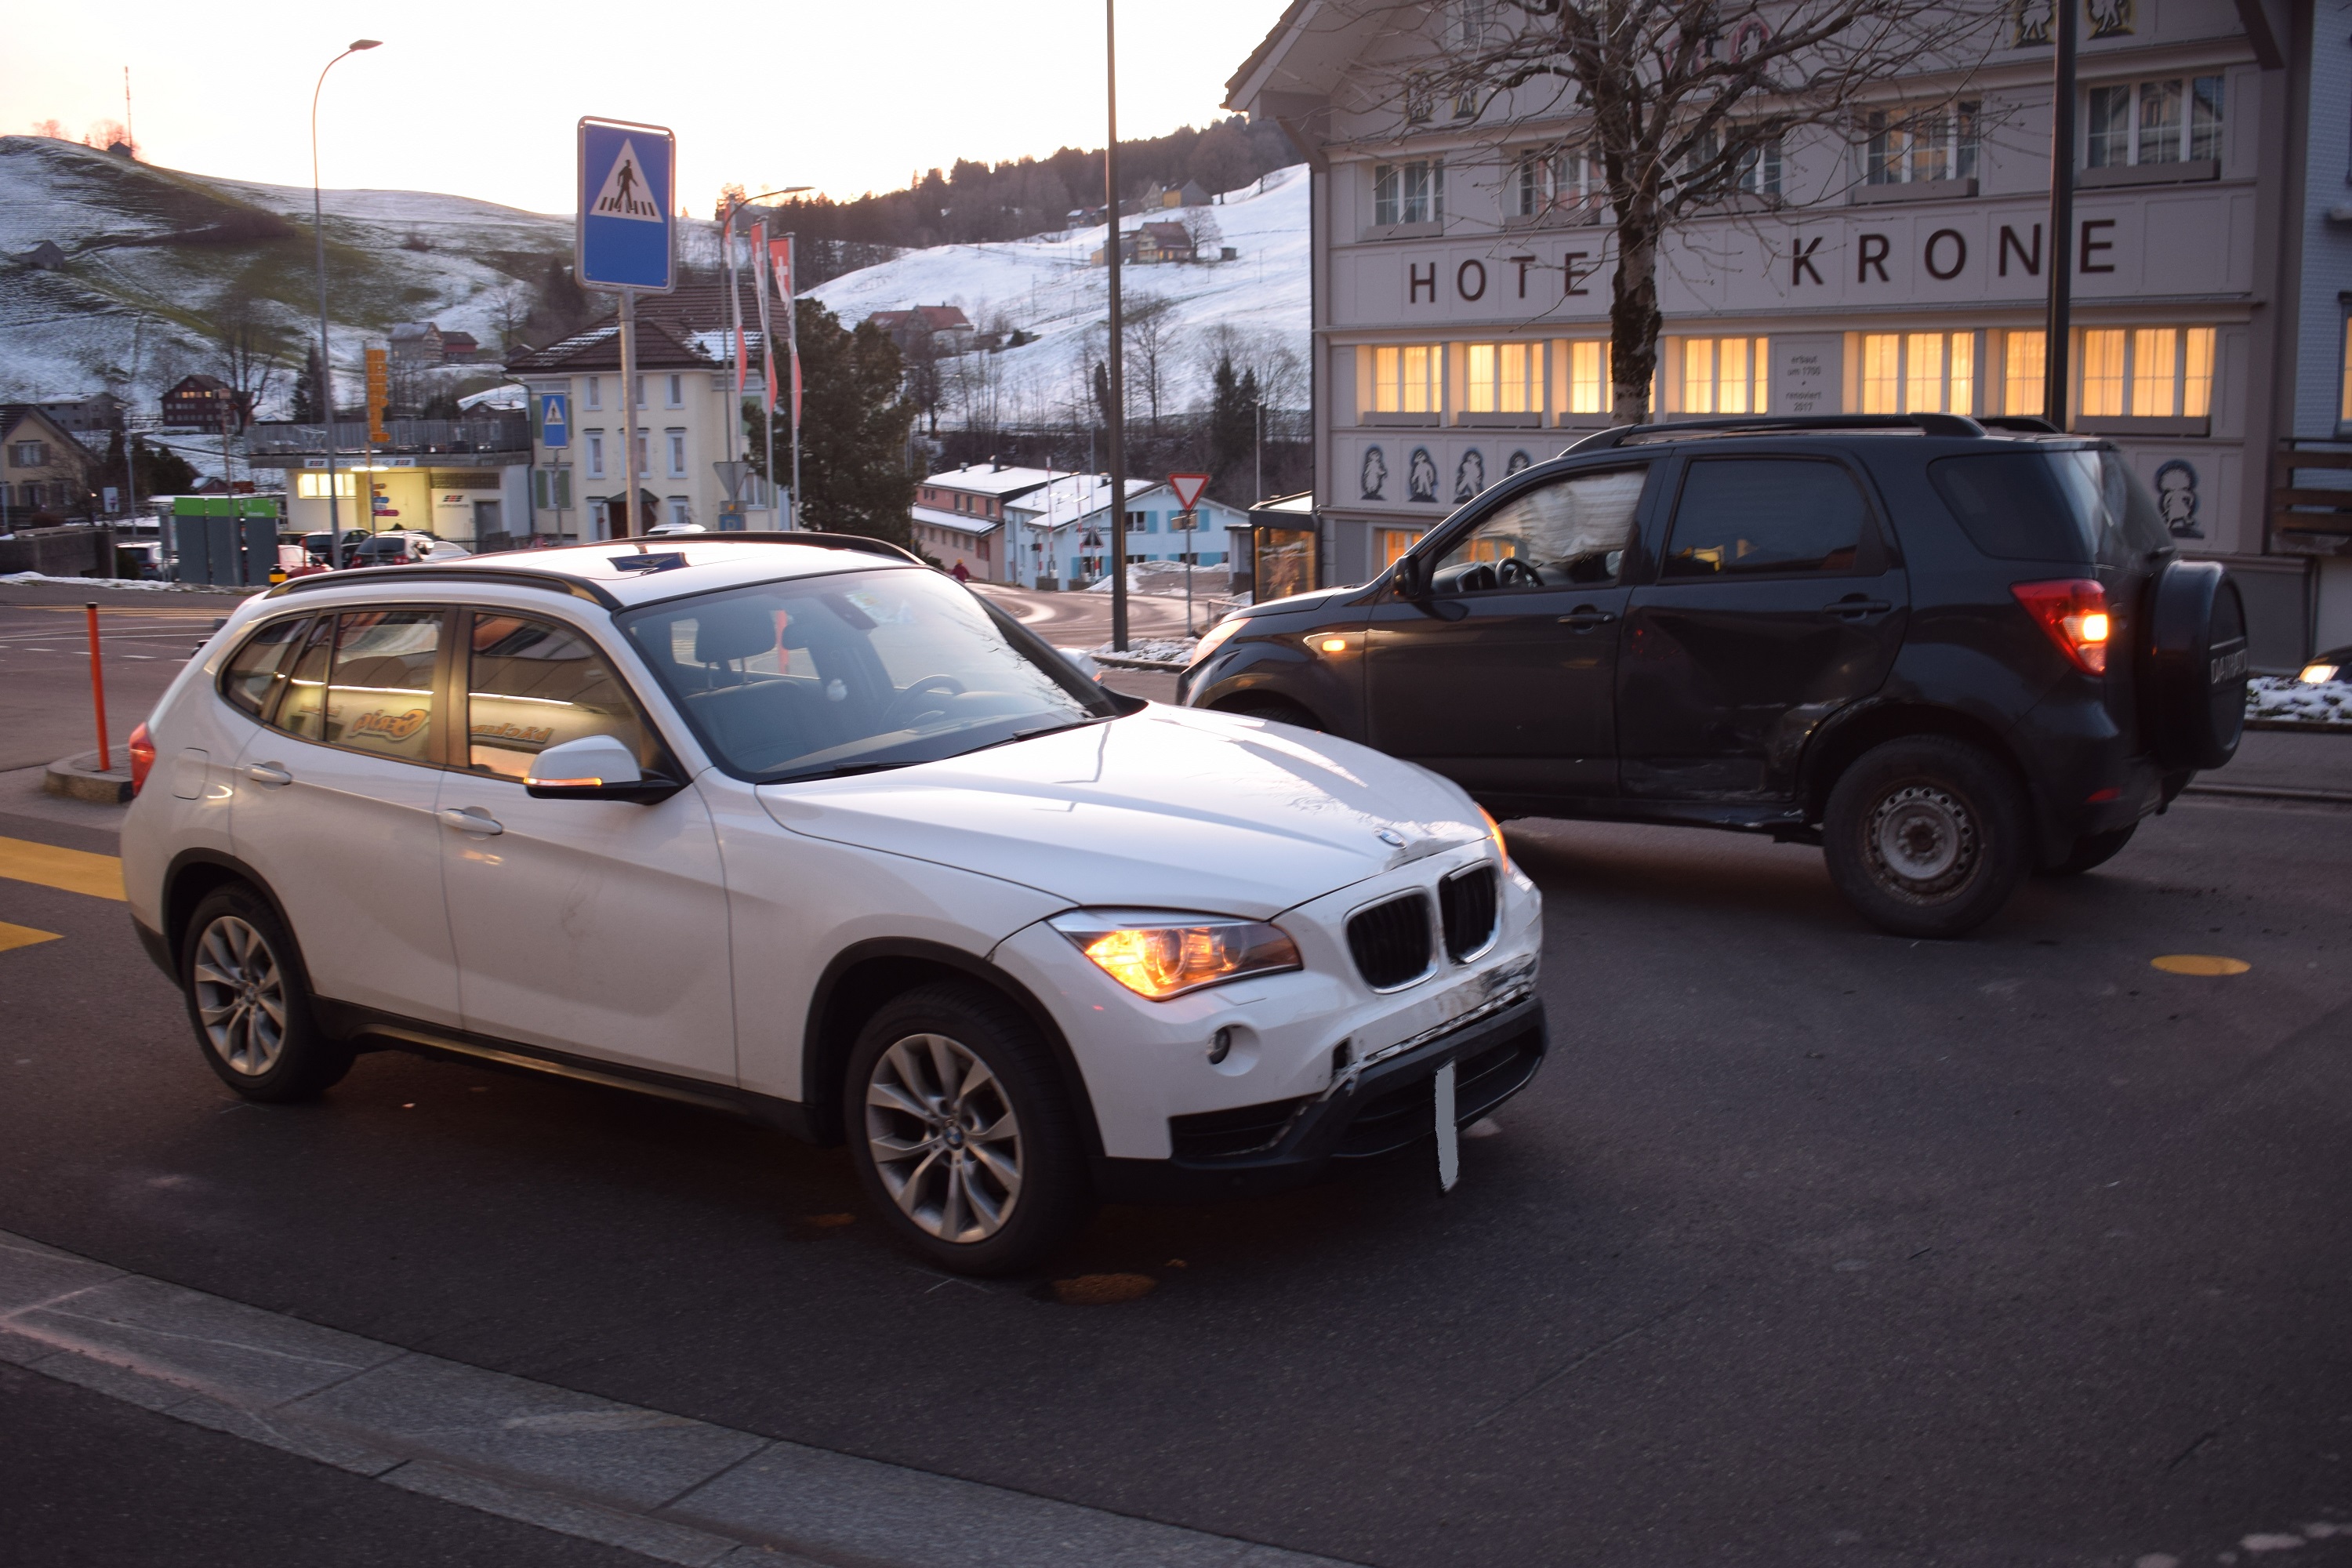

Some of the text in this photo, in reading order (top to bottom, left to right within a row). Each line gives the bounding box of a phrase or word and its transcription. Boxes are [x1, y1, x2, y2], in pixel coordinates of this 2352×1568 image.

[1410, 219, 2116, 304] HOTE KRONE
[1786, 391, 1821, 401] renoviert
